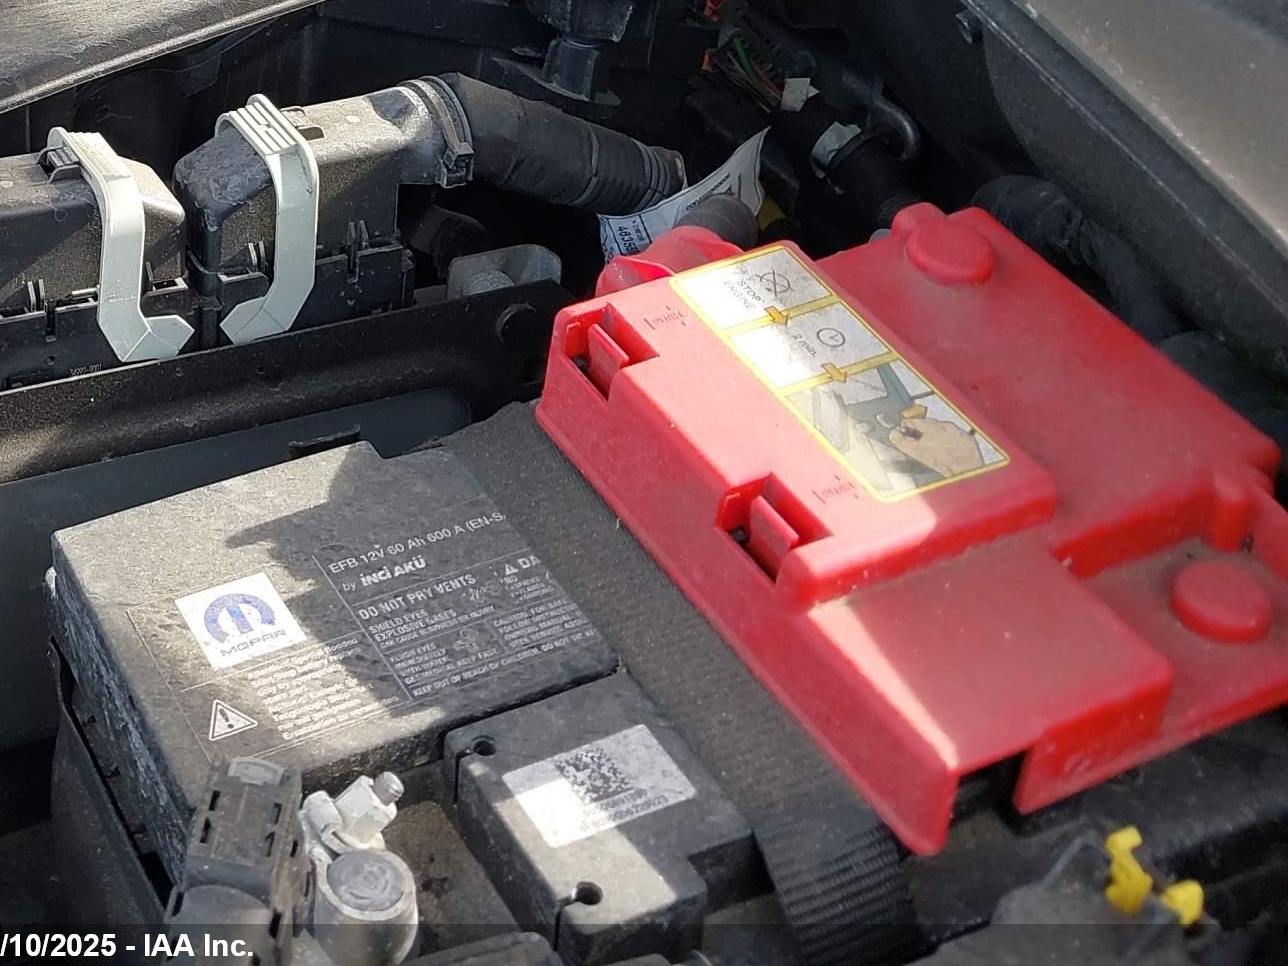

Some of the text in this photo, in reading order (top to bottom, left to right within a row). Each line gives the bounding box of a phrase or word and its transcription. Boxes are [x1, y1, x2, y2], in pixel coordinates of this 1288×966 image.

[328, 557, 359, 573] EFB
[359, 548, 386, 563] 12V
[386, 543, 406, 554] 60
[404, 536, 426, 549] Ah
[425, 528, 452, 542] 600
[450, 523, 466, 534] A
[341, 581, 358, 591] by
[358, 606, 379, 619] DO
[378, 597, 406, 612] NOT
[406, 587, 435, 603] PRY
[433, 574, 476, 593] VENTS
[368, 609, 428, 633] SHIELD EYES
[374, 620, 425, 641] EXPLOSIVE
[220, 629, 287, 657] MOPAR
